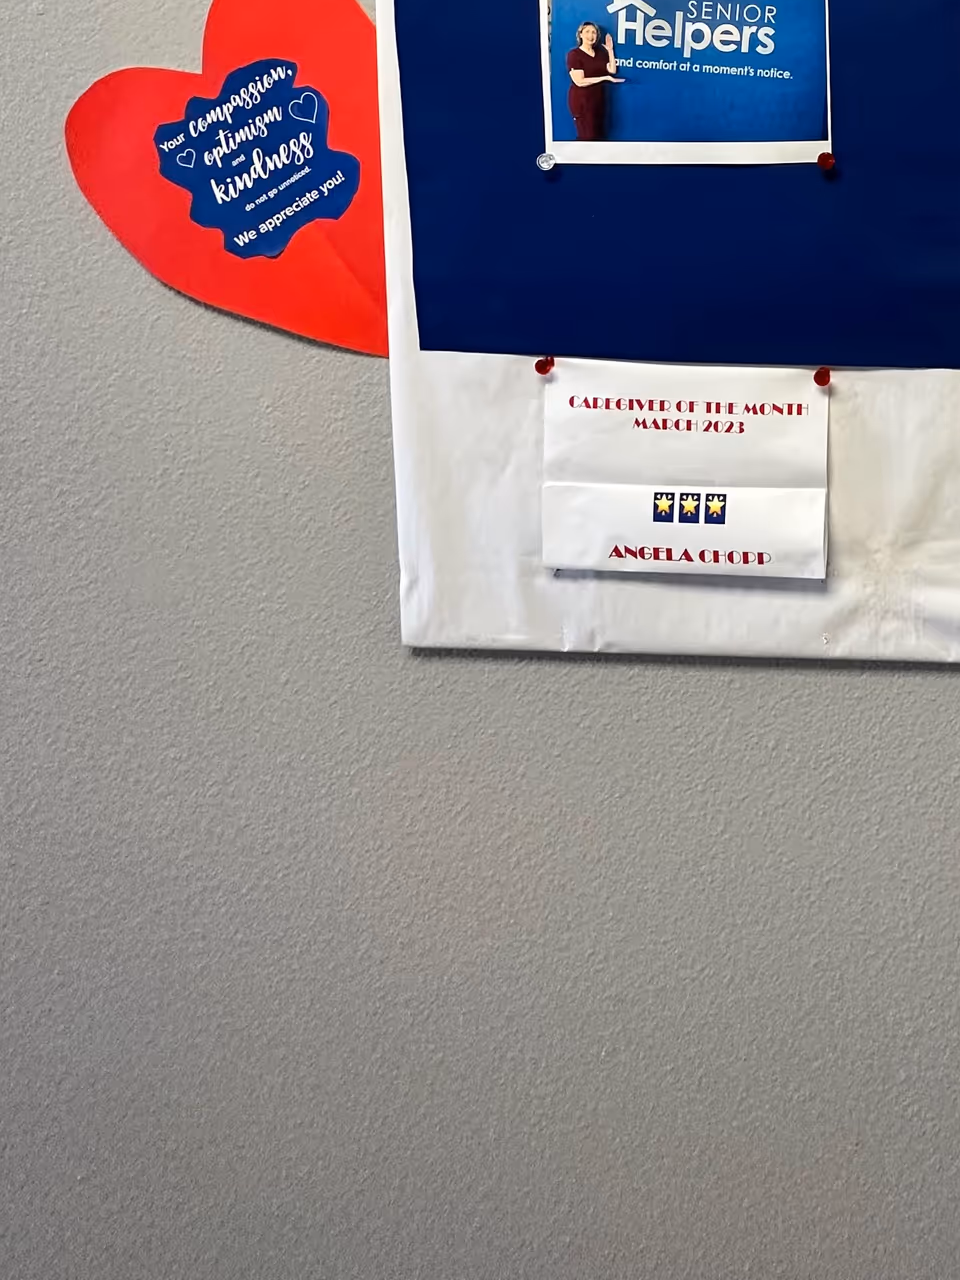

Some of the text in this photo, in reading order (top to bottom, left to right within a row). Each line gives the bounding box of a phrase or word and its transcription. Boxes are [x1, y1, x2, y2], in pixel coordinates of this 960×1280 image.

[686, 0, 777, 24] SENIOR
[617, 9, 776, 58] Helpers
[636, 59, 677, 70] comfort
[679, 62, 691, 71] at
[693, 64, 700, 72] a
[702, 64, 755, 76] moment's
[757, 67, 793, 79] notice.
[159, 66, 292, 153] Your compassion,
[203, 106, 283, 168] optimism
[210, 131, 314, 204] kindness
[232, 154, 245, 166] and
[245, 166, 312, 211] do not go unnoticed.
[233, 170, 346, 247] We appreciate you!
[568, 395, 809, 416] CAREGIVER OF THE MONTH
[633, 417, 745, 434] MARCH 2023
[608, 545, 694, 562] ANGELA
